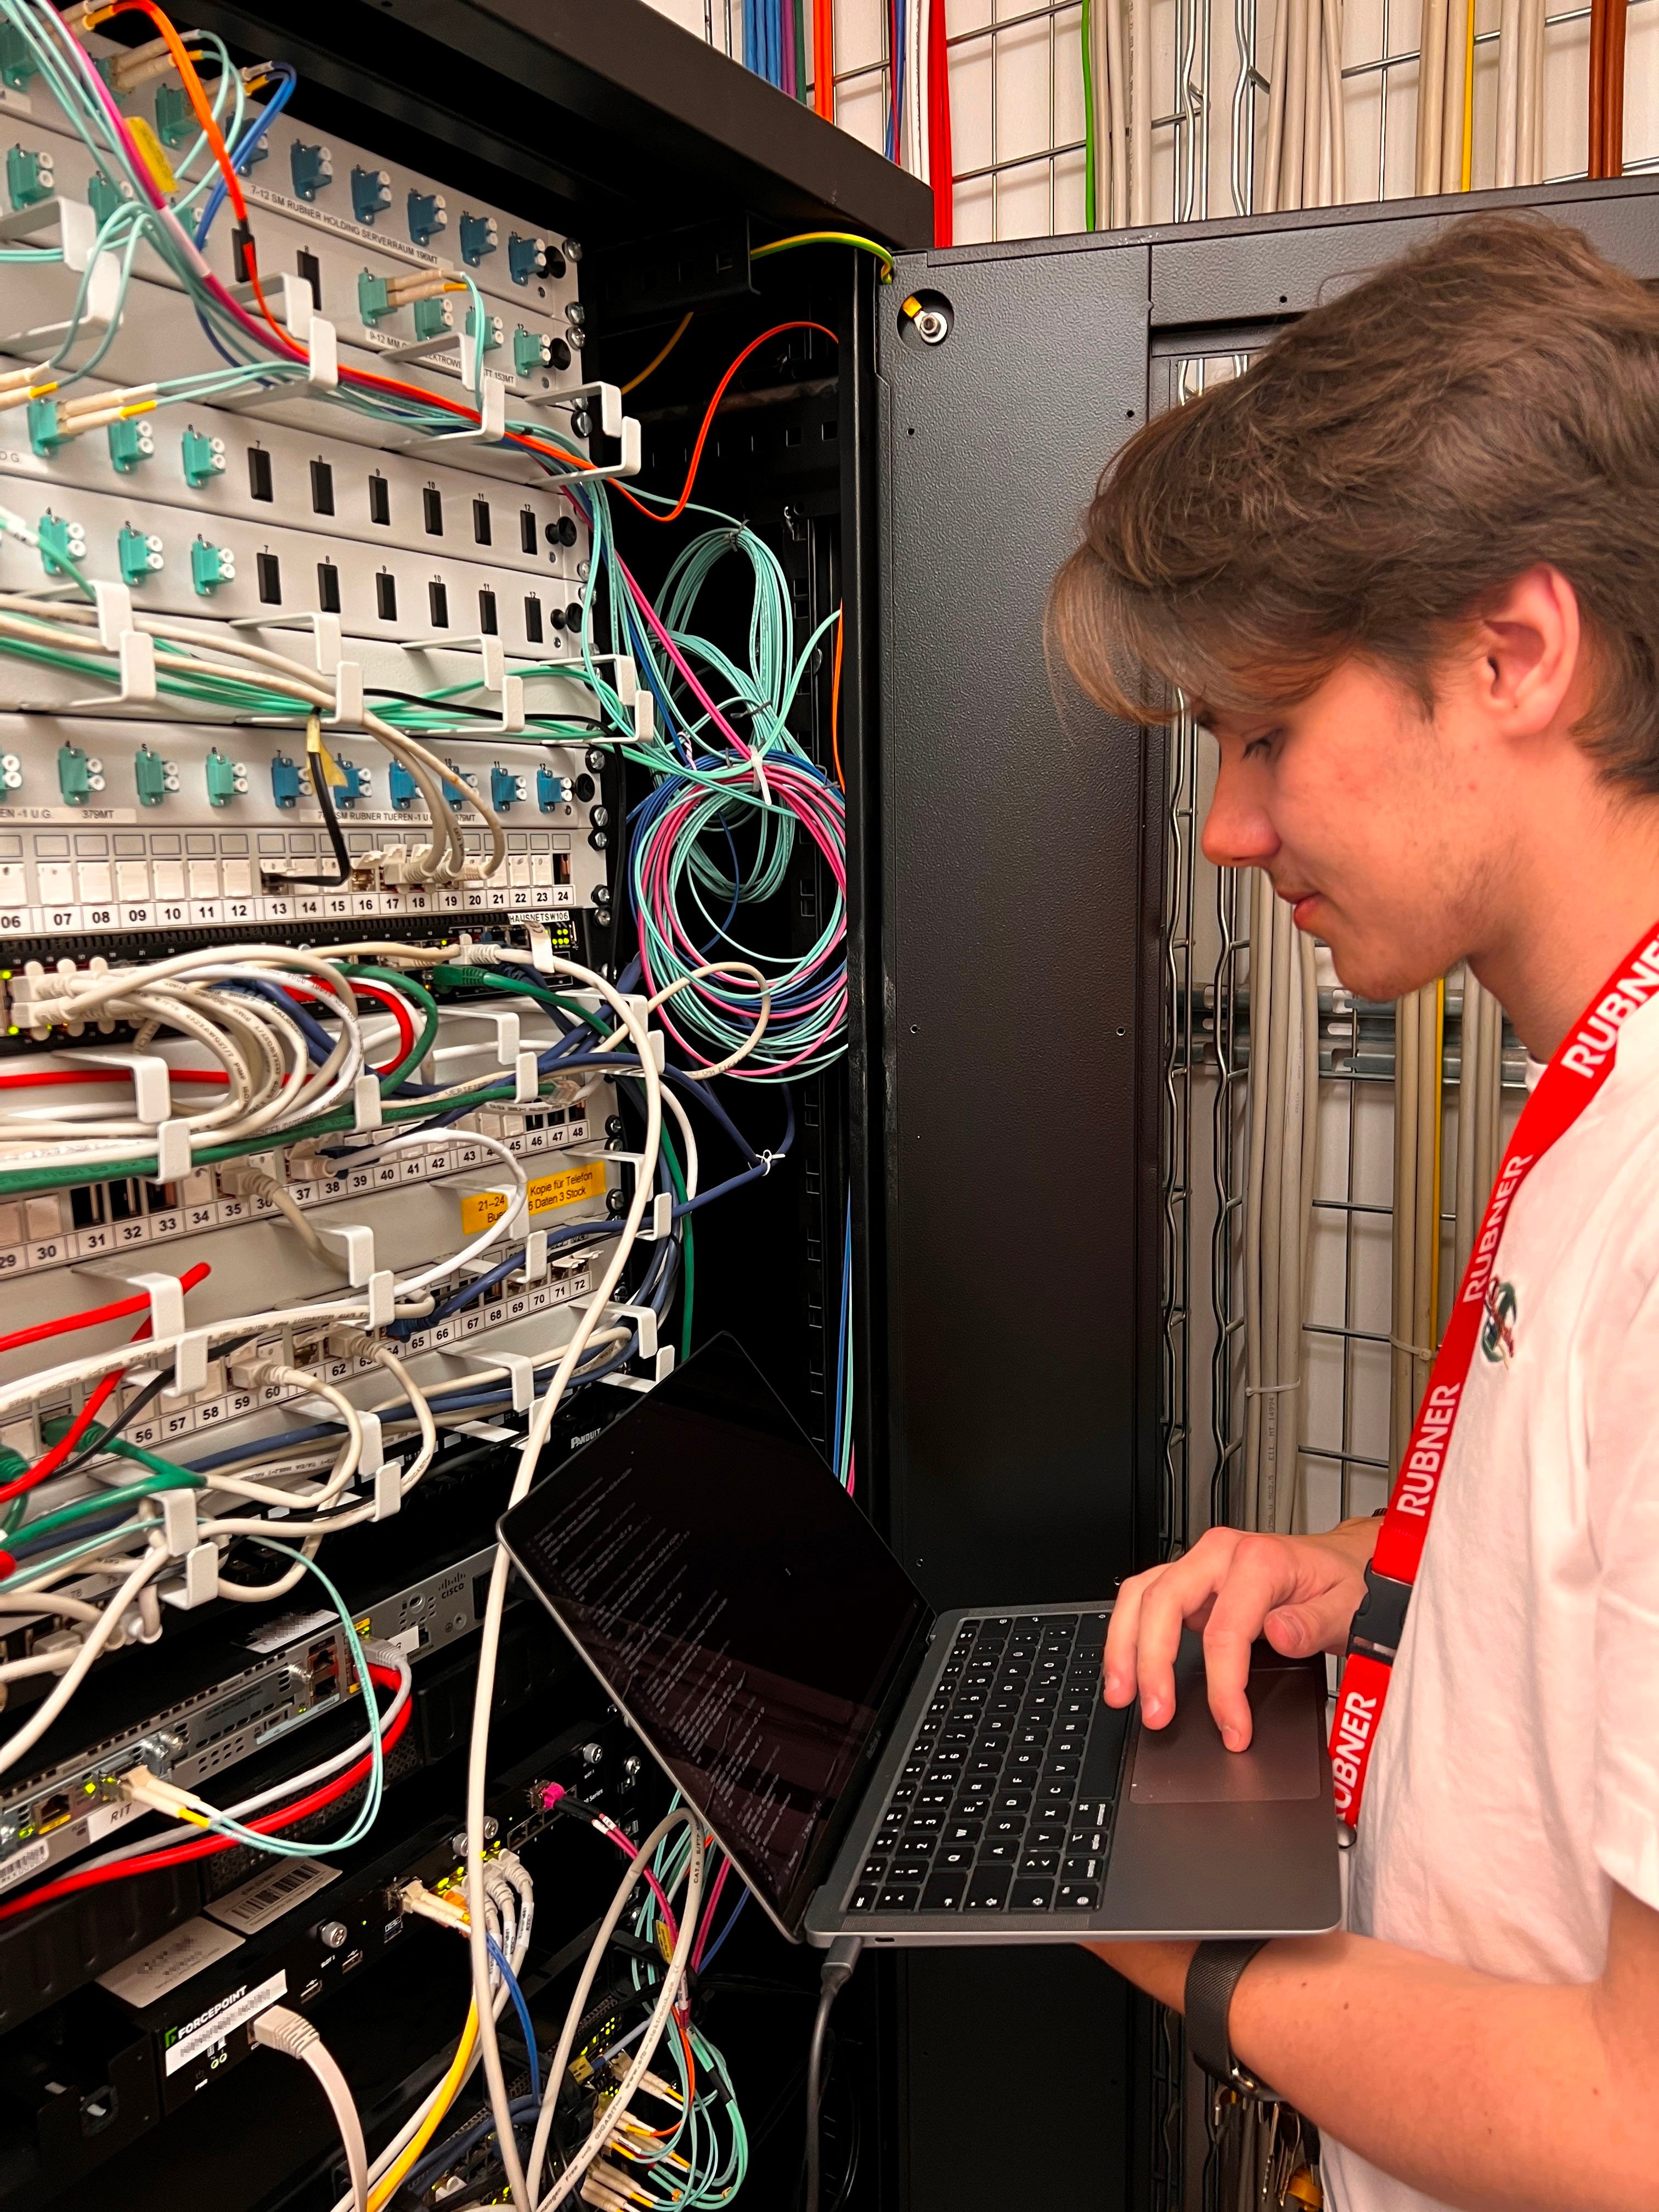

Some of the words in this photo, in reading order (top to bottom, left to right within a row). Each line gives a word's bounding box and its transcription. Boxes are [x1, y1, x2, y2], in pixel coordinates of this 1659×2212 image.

[271, 193, 285, 206] SM
[287, 199, 321, 221] RUBNER
[323, 216, 360, 235] HOLDING
[362, 229, 415, 256] SERVERRAUM
[494, 371, 514, 383] 153MT
[349, 812, 382, 821] RUBNER
[383, 813, 413, 821] TUEREN
[1, 915, 21, 928] 06
[54, 913, 72, 926] 07
[92, 911, 111, 923] 08
[129, 910, 147, 922] 09
[164, 908, 182, 920] 10
[199, 906, 215, 918] 11
[231, 905, 248, 917] 12
[272, 903, 287, 915] 13
[302, 902, 317, 913] 14
[331, 900, 346, 912] 15
[359, 899, 373, 910] 16
[386, 898, 399, 909] 17
[412, 897, 425, 908] 18
[445, 896, 457, 906] 19
[469, 895, 481, 905] 20
[493, 894, 504, 904] 21
[515, 893, 527, 903] 22
[537, 892, 548, 902] 23
[557, 891, 568, 901] 24
[510, 911, 568, 923] HAUSNETSW106
[1560, 933, 1659, 1079] RUBNE
[0, 1254, 16, 1269] 29
[37, 1245, 57, 1260] 30
[88, 1234, 105, 1248] 31
[123, 1226, 142, 1240] 32
[159, 1218, 177, 1232] 33
[193, 1210, 210, 1224] 34
[225, 1203, 242, 1216] 35
[296, 1188, 311, 1200] 37
[325, 1181, 340, 1193] 38
[353, 1175, 368, 1187] 39
[381, 1169, 394, 1181] 40
[407, 1163, 420, 1175] 41
[432, 1158, 445, 1169] 42
[464, 1150, 476, 1161] 43
[487, 1148, 495, 1156] 4
[509, 1141, 521, 1150] 45
[531, 1136, 543, 1146] 46
[552, 1131, 563, 1141] 47
[573, 1127, 584, 1137] 48
[530, 1183, 552, 1197] Kopie
[554, 1180, 565, 1190] für
[566, 1171, 593, 1186] Telefon
[535, 1196, 558, 1209] Daten
[559, 1192, 565, 1202] 3
[566, 1186, 586, 1199] Stock
[1460, 1153, 1535, 1305] RUBNER
[136, 1428, 153, 1443] 56
[170, 1417, 187, 1431] 57
[202, 1407, 219, 1420] 58
[235, 1396, 250, 1409] 59
[265, 1385, 280, 1399] 60
[332, 1363, 346, 1376] 62
[411, 1336, 425, 1349] 65
[436, 1328, 449, 1340] 66
[467, 1317, 479, 1329] 67
[490, 1309, 502, 1321] 68
[512, 1302, 524, 1313] 69
[533, 1294, 545, 1305] 70
[555, 1286, 565, 1297] 71
[574, 1279, 585, 1290] 72
[571, 1427, 601, 1449] PANDUIT
[1396, 1382, 1461, 1518] RUBNER
[441, 1582, 465, 1599] CISCO
[1332, 1691, 1377, 1820] UBNER
[110, 1802, 133, 1824] RIT
[178, 1985, 247, 2039] FORCEPOINT
